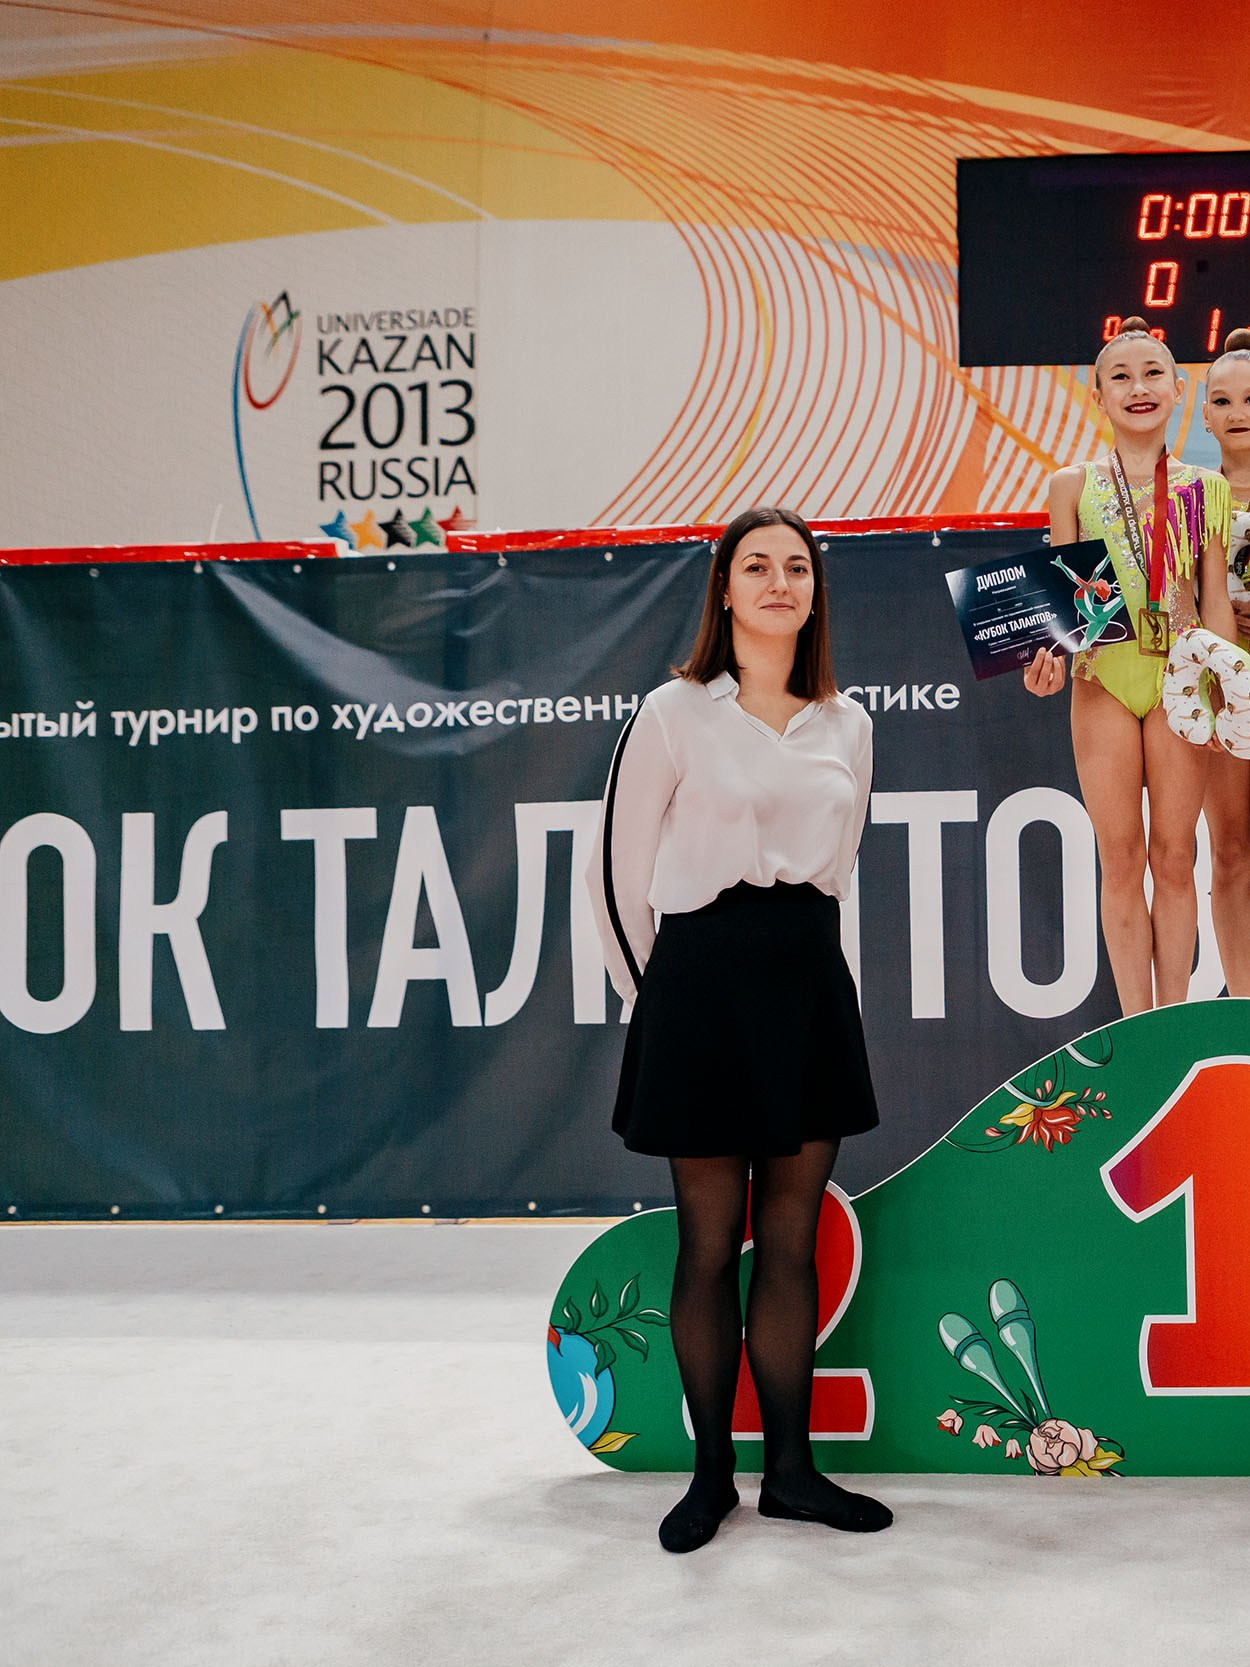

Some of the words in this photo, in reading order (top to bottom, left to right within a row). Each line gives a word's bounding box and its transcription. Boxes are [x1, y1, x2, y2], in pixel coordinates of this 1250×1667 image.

[1144, 261, 1179, 307] 0
[317, 307, 476, 333] UNIVERSIADE
[318, 333, 476, 375] KAZAN
[319, 379, 476, 450] 2013
[319, 456, 477, 501] RUSSIA
[976, 565, 1026, 592] ДИПЛОМ
[974, 622, 1008, 641] «КУБОК
[1008, 611, 1057, 632] ТАЛАНТОВ»
[111, 704, 258, 746] турнир
[271, 703, 319, 731] по
[331, 694, 638, 740] художественн
